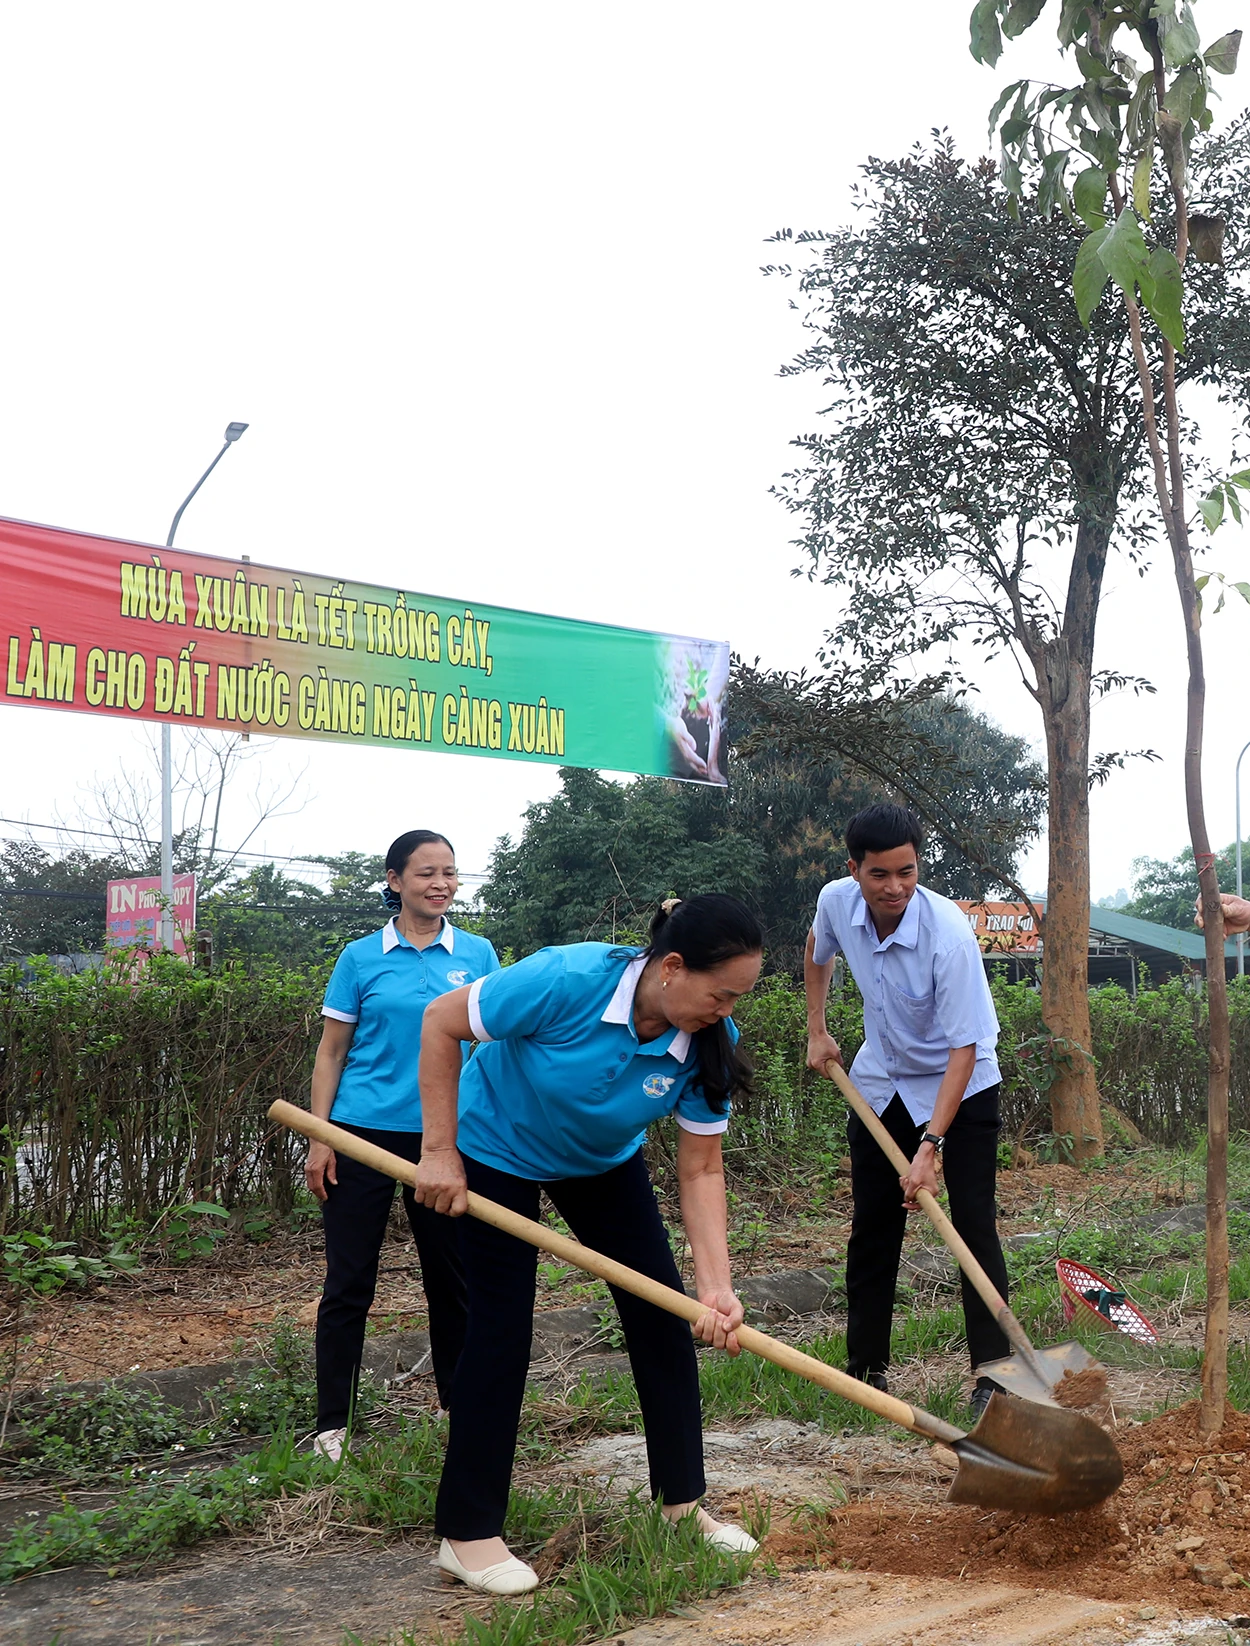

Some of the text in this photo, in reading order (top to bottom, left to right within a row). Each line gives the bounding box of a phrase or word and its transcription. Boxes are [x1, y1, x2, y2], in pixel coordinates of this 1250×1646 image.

[120, 555, 493, 676] MÙA XUÂN LÀ TẾT TRỒNG CÂY,
[6, 626, 565, 756] LÀM CHO ĐẤT NƯỚC CÀNG NGÀY CÀNG XUÂN
[110, 884, 191, 913] IN PHOOPY
